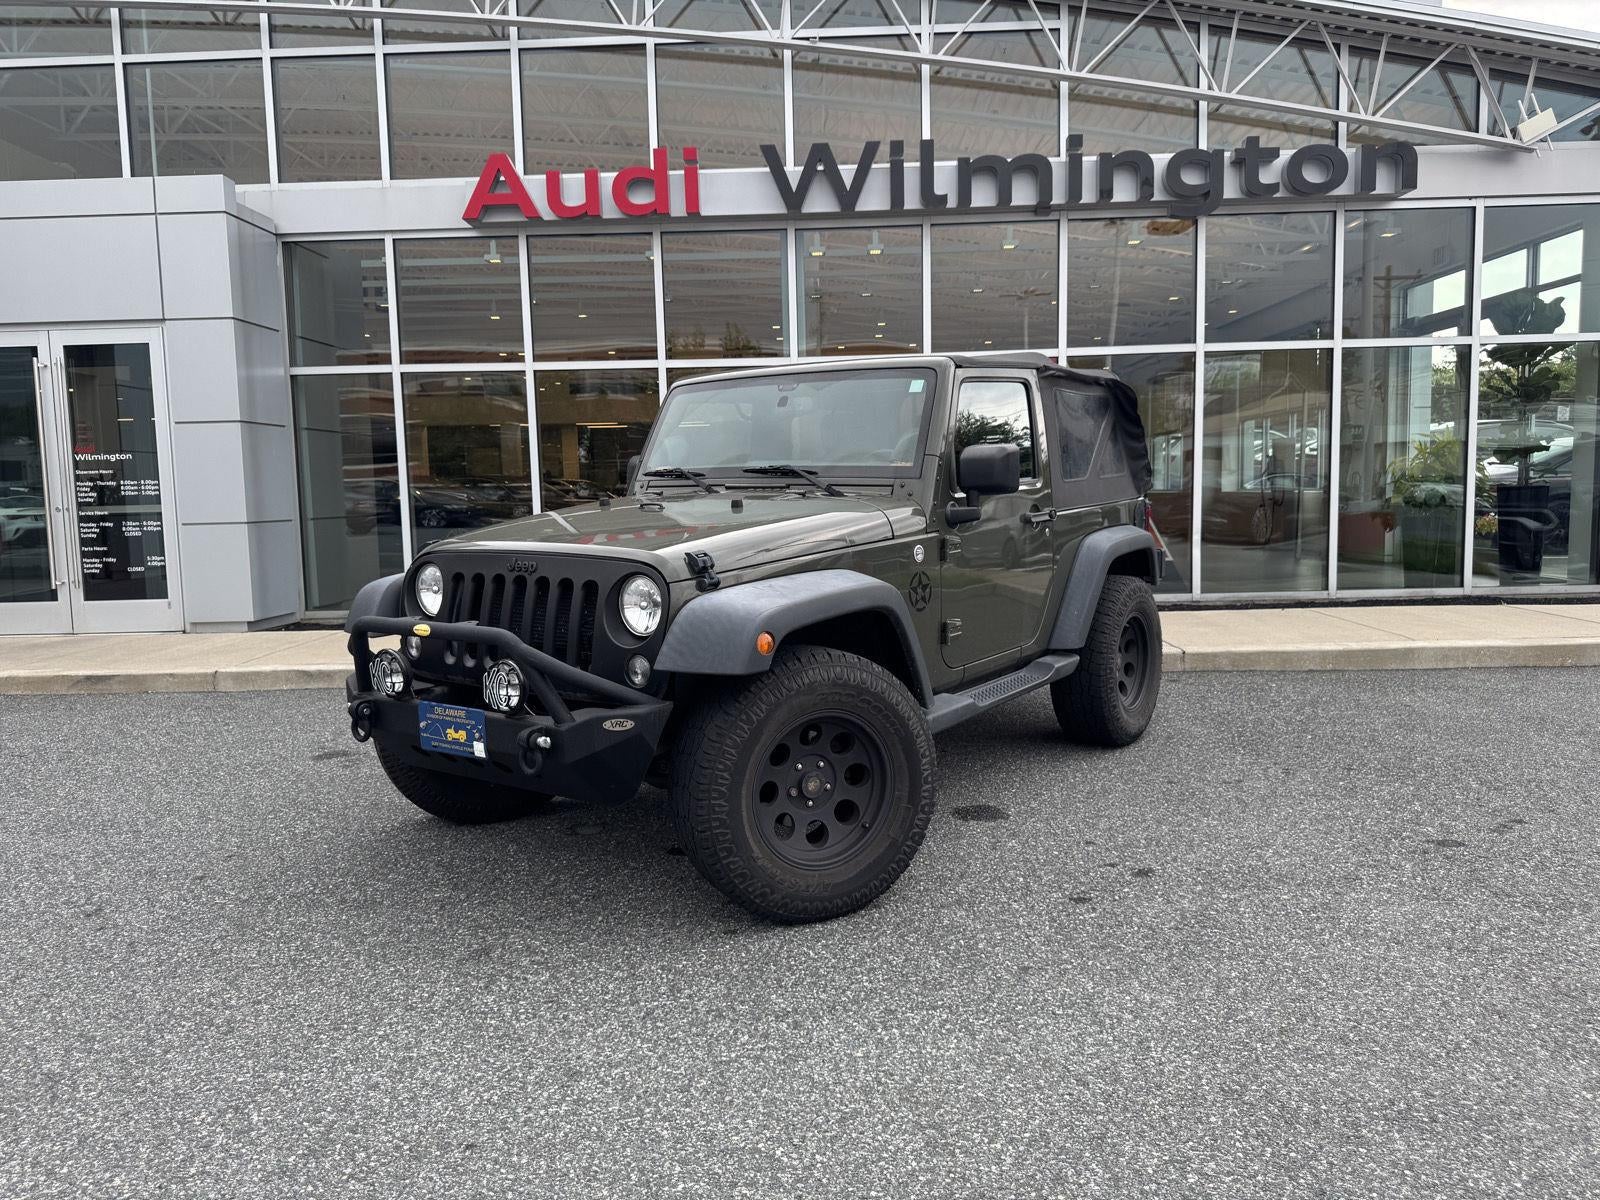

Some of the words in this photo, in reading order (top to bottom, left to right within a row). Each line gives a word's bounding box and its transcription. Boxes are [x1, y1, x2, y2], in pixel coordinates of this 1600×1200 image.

[462, 147, 701, 221] Audi
[760, 134, 1418, 218] Wilmington
[507, 558, 537, 576] Jeep
[369, 658, 394, 695] KC
[483, 668, 508, 710] KC
[434, 706, 466, 718] DELAWARE
[606, 720, 629, 729] XRC
